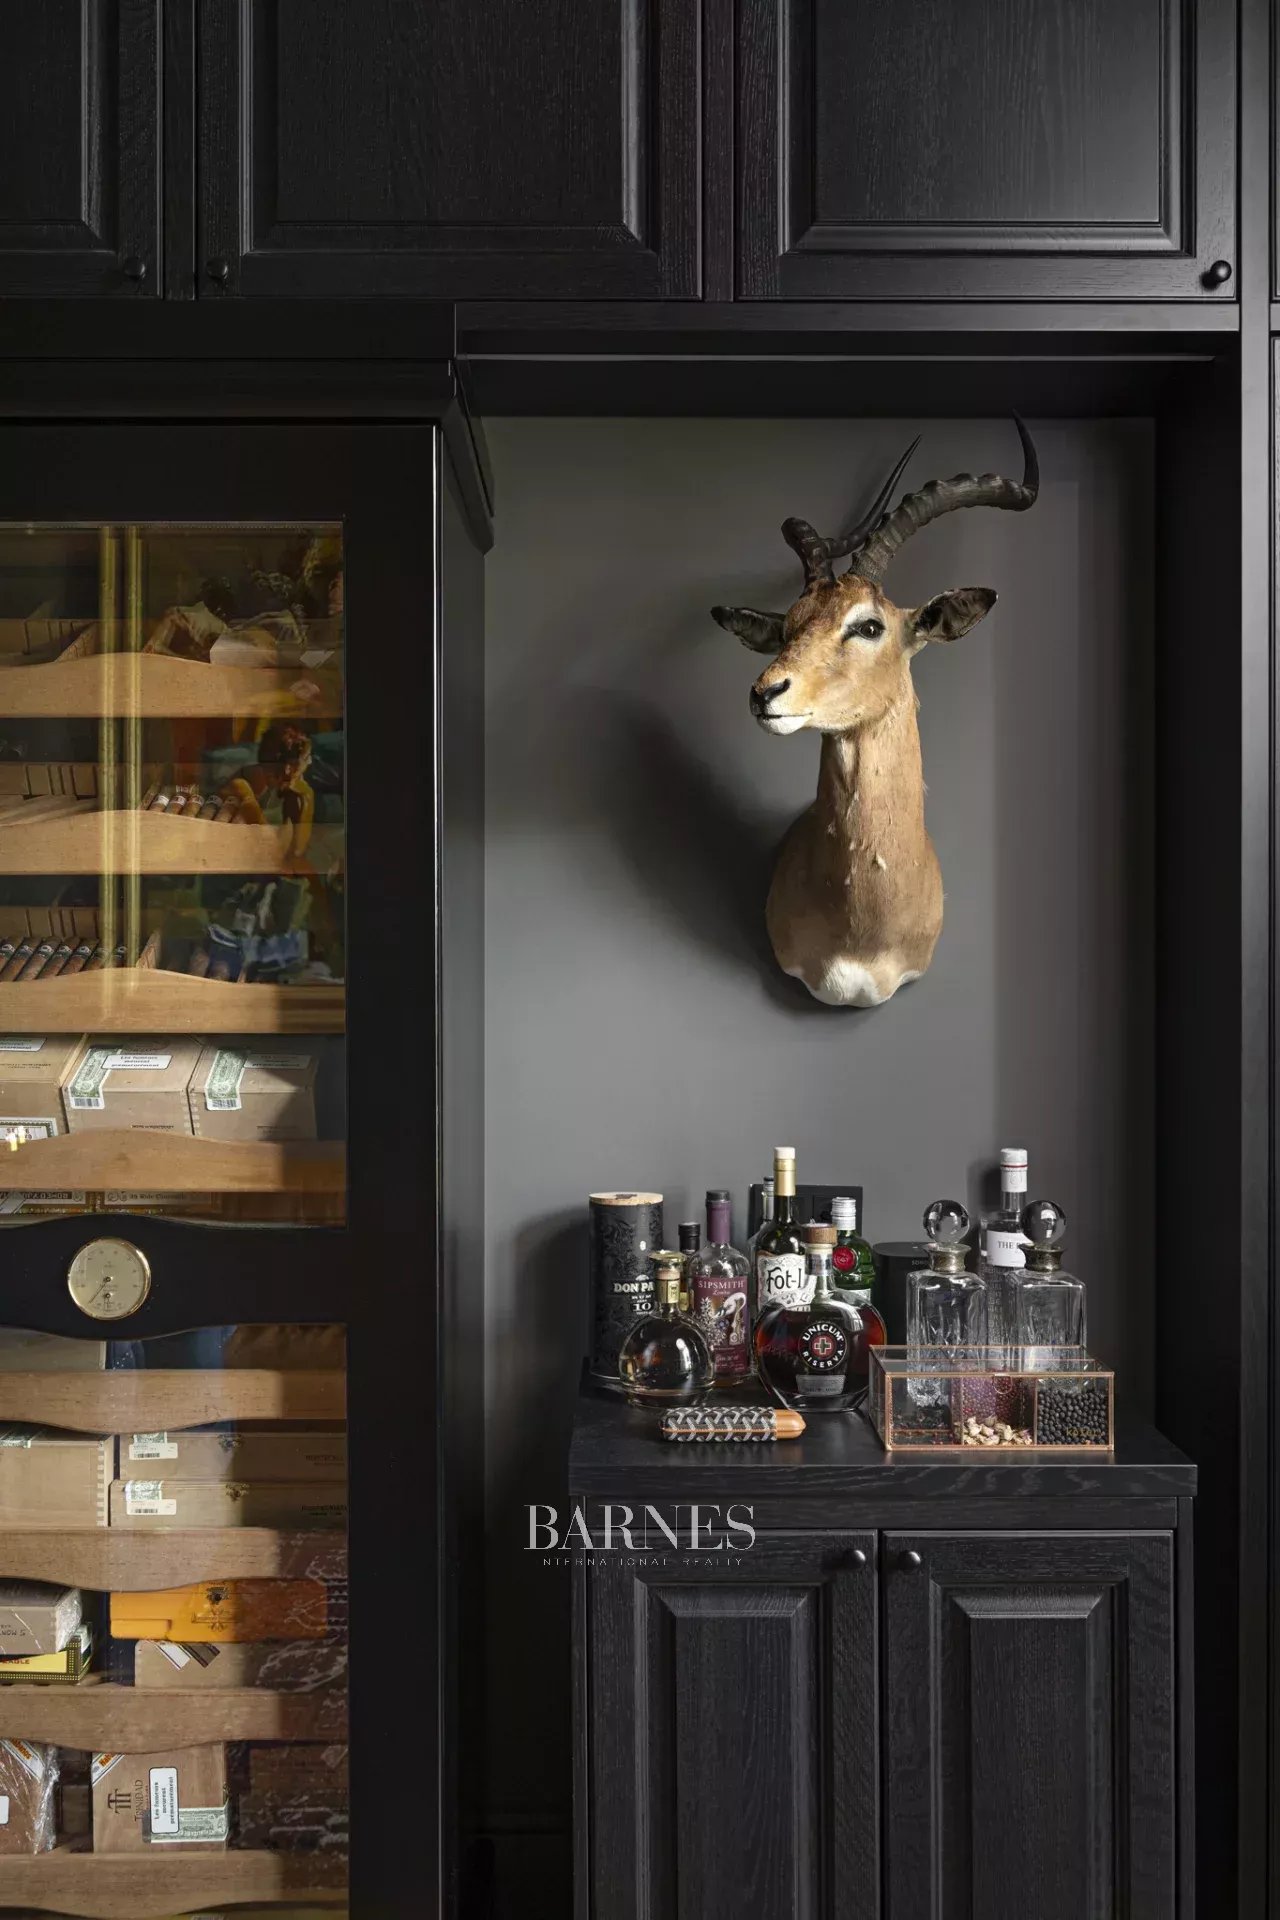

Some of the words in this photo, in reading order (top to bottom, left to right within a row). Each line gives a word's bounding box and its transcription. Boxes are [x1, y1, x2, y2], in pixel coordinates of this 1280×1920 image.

[997, 1241, 1013, 1249] THE
[613, 1282, 639, 1293] DON
[641, 1281, 654, 1292] PA
[698, 1281, 744, 1289] SIPSMITH
[632, 1302, 651, 1311] 10
[802, 1324, 844, 1342] UNICUM
[802, 1350, 843, 1368] RISERVA
[133, 1779, 143, 1822] TRINIDAD
